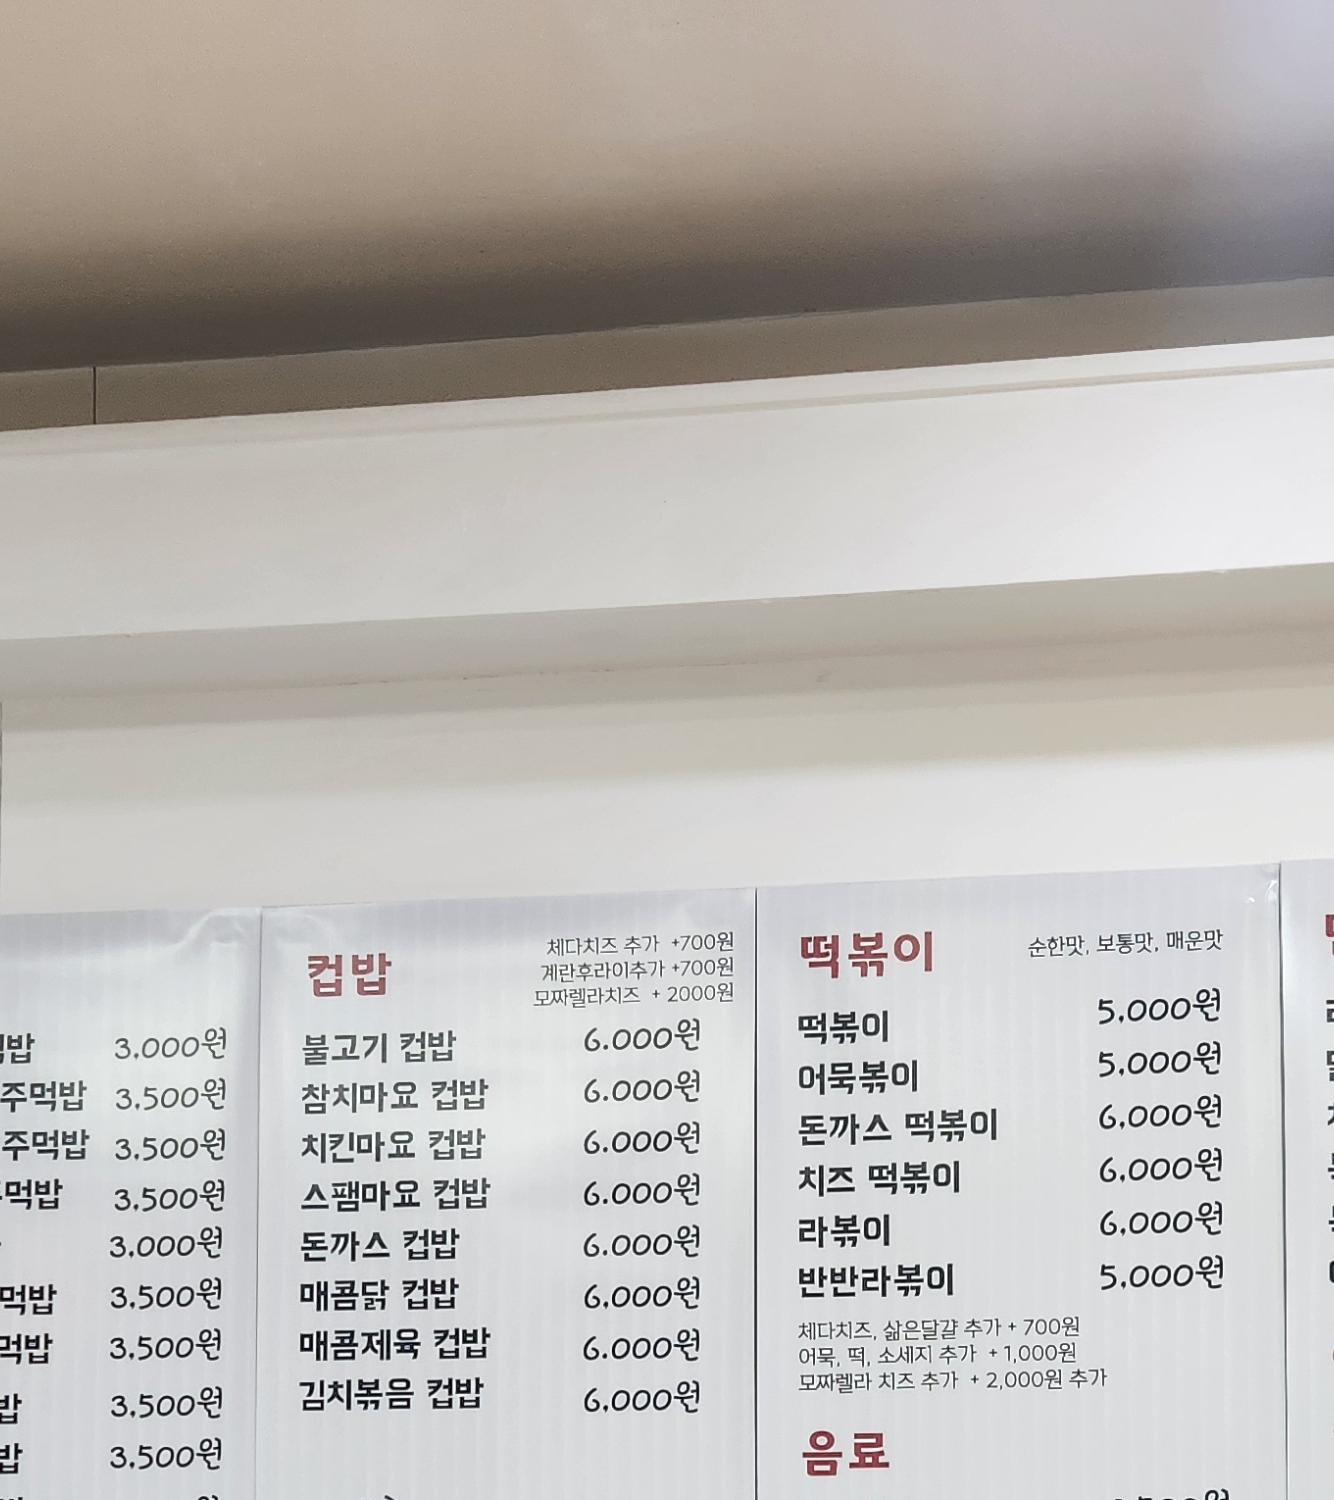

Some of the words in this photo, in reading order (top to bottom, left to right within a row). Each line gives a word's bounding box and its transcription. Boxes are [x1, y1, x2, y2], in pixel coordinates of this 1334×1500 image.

[547, 937, 618, 956] 체다치즈
[624, 935, 660, 955] 추가
[801, 931, 932, 979] 떡볶이
[1028, 935, 1089, 957] 순한맛,
[1096, 932, 1158, 954] 보통맛,
[1166, 929, 1223, 951] 매운맛
[308, 953, 392, 997] 컵밥
[533, 987, 641, 1008] 모짜렐라치즈
[798, 1010, 888, 1045] 떡볶이
[1098, 988, 1220, 1025] 5,000원
[302, 1033, 387, 1066] 불고기
[400, 1030, 456, 1063] 컵밥
[799, 1059, 917, 1095] 어묵볶이
[1099, 1041, 1221, 1078] 5,000원
[798, 1113, 892, 1146] 돈까스
[905, 1108, 997, 1143] 떡볶이
[1099, 1094, 1221, 1130] 6,000원
[2, 1129, 90, 1161] 주먹밥
[798, 1164, 855, 1197] 치즈
[869, 1160, 959, 1195] 떡볶이
[1099, 1147, 1222, 1183] 6,000원
[301, 1180, 420, 1212] 스팸마요
[433, 1177, 491, 1210] 컵밥
[799, 1214, 890, 1248] 라볶이
[1100, 1201, 1222, 1236] 6,000원
[799, 1263, 953, 1298] 반반라볶이
[1100, 1255, 1223, 1290] 5,000원
[300, 1279, 390, 1312] 매콤닭
[402, 1277, 459, 1310] 컵밥
[798, 1321, 877, 1341] 체다치즈,
[883, 1319, 958, 1341] 삶은달걀
[964, 1318, 1002, 1338] 추가
[799, 1348, 840, 1368] 어묵,
[847, 1347, 870, 1368] 떡,
[878, 1345, 932, 1364] 소세지
[939, 1344, 977, 1365] 추가
[299, 1378, 414, 1411] 김치볶음
[427, 1377, 484, 1409] 컵밥
[798, 1372, 872, 1394] 모짜렐라
[878, 1372, 915, 1390] 치즈
[921, 1371, 959, 1391] 추가
[1069, 1368, 1107, 1389] 추가
[802, 1430, 890, 1476] 음료
